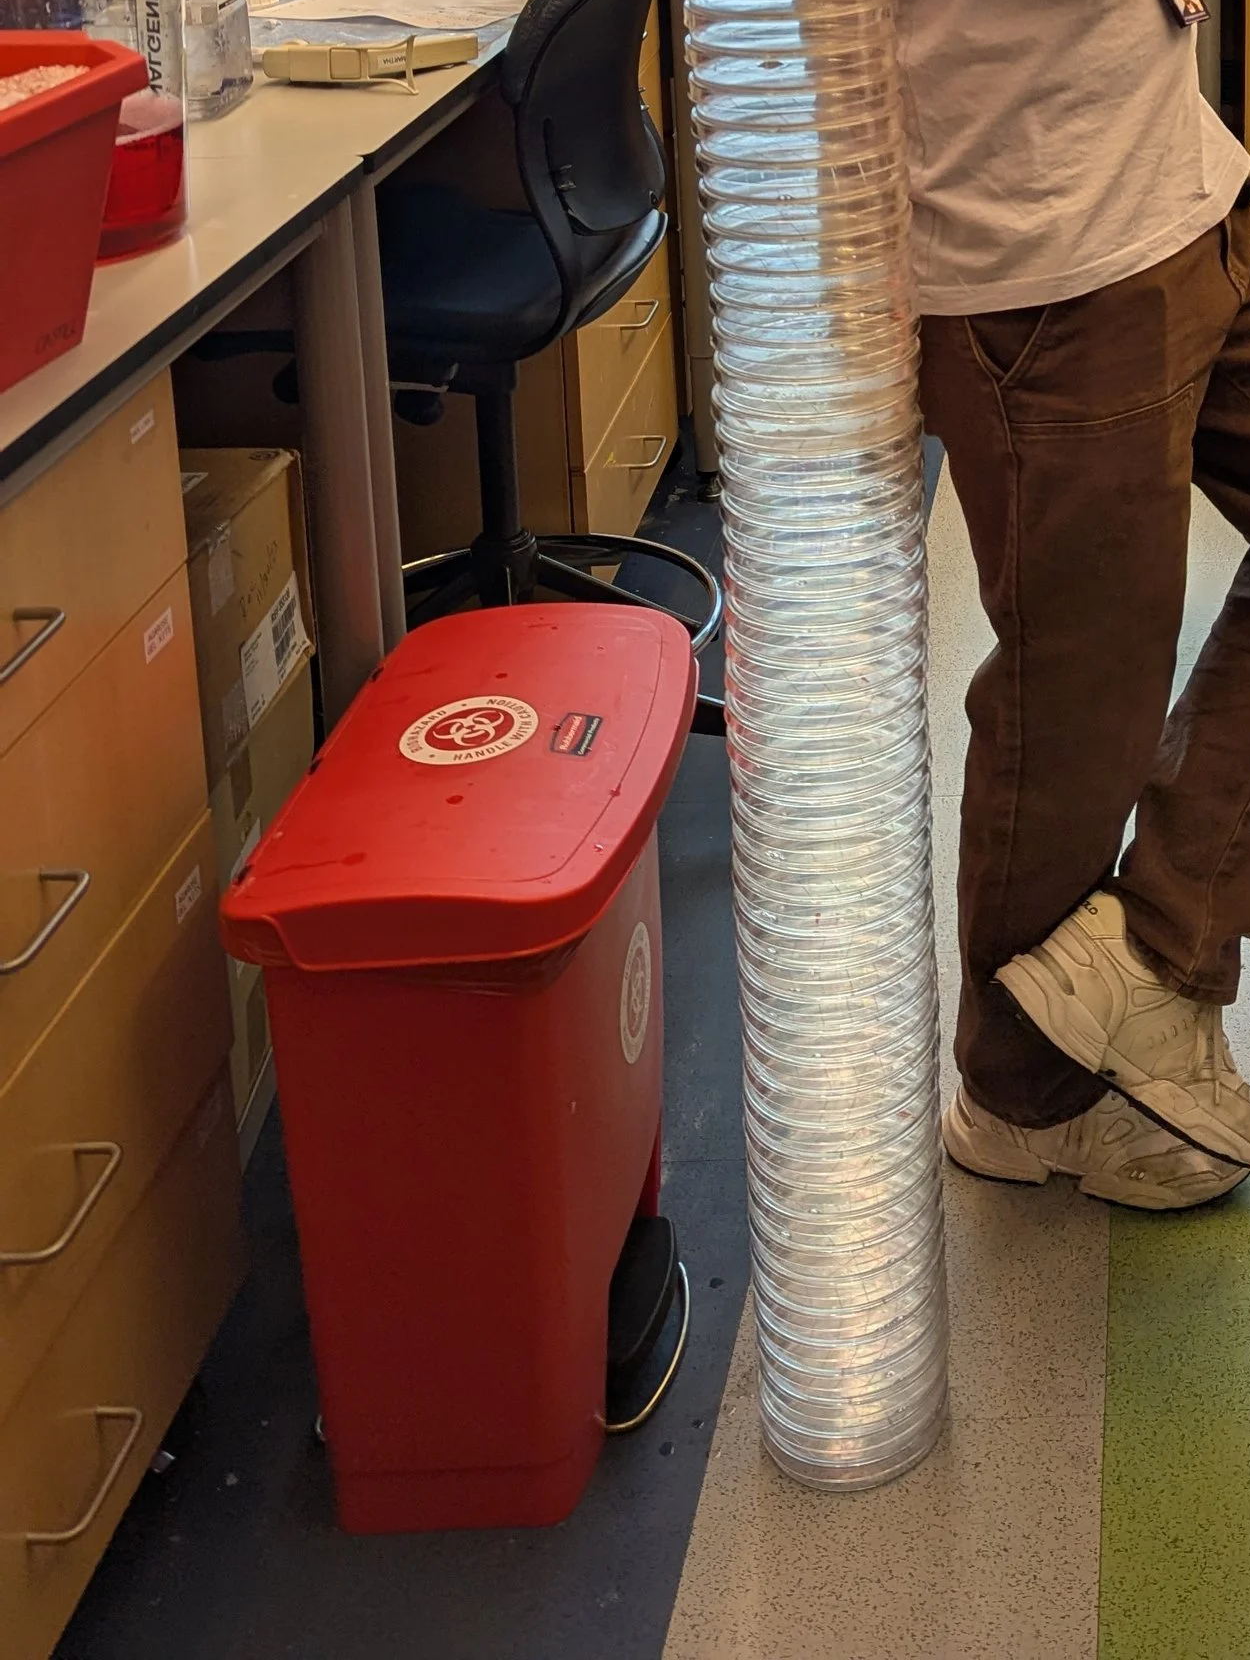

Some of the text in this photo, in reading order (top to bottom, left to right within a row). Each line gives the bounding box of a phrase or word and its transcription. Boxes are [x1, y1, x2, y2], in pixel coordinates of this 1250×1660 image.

[486, 698, 532, 721] CAUTION
[405, 709, 448, 754] BIOHAZARD
[452, 719, 533, 761] HANDLE WITH
